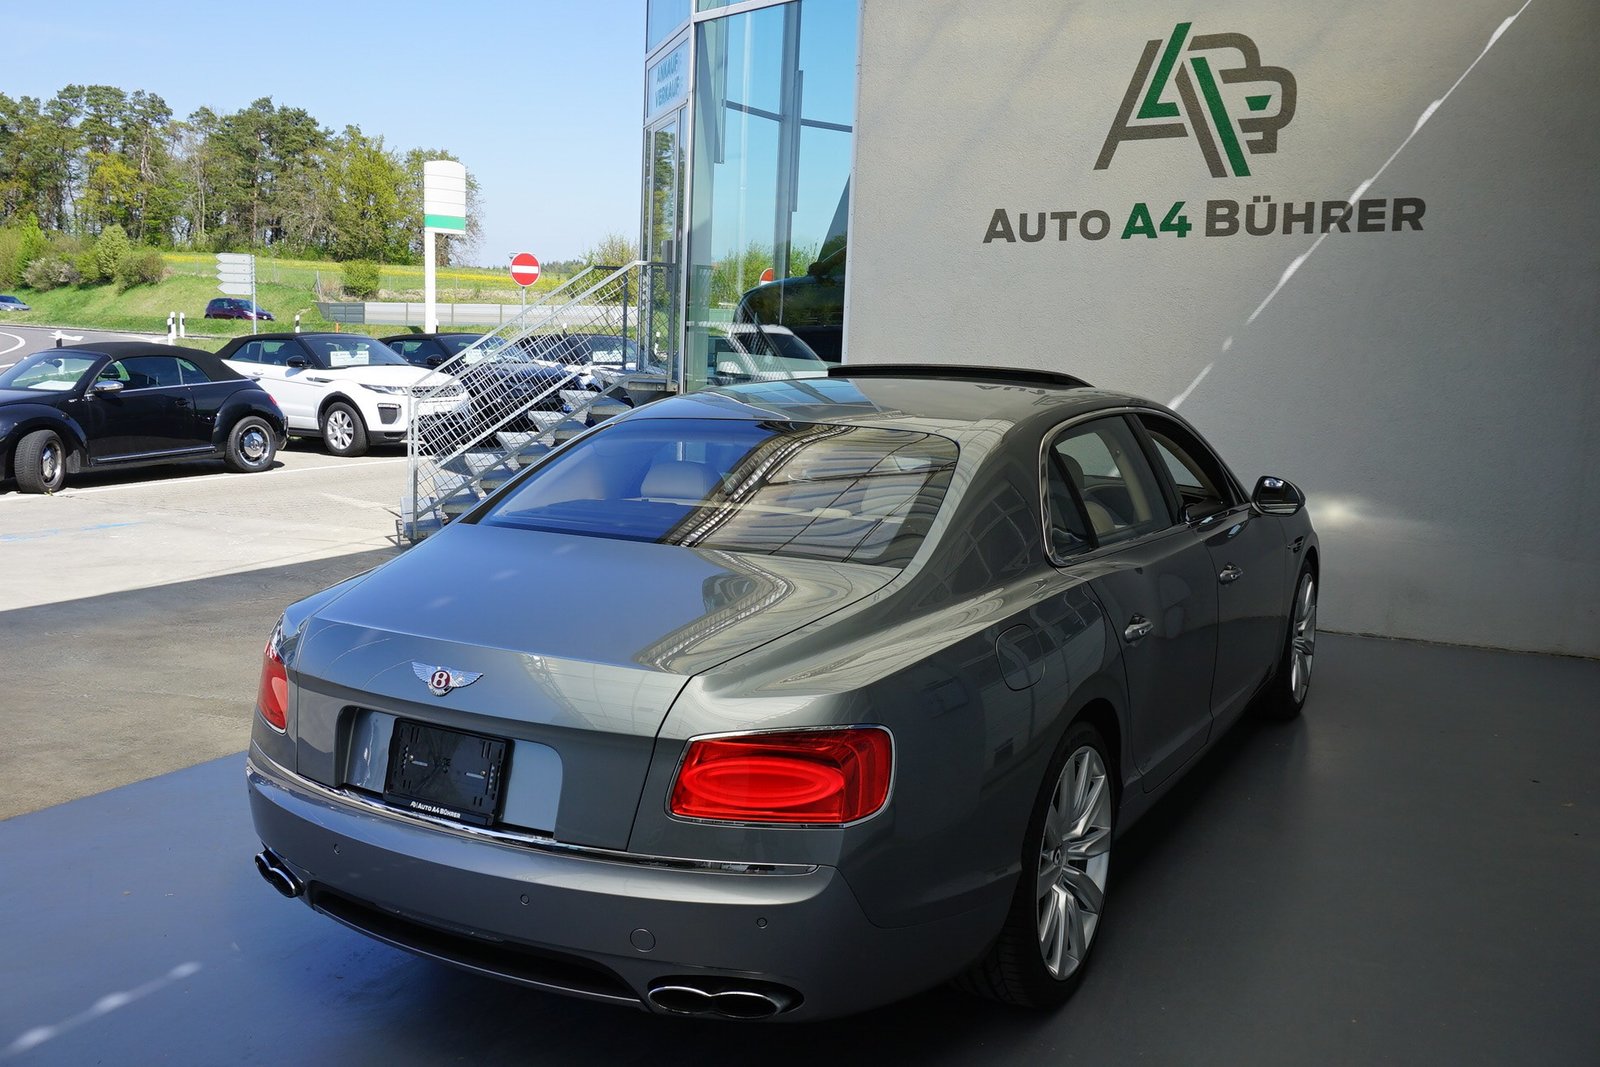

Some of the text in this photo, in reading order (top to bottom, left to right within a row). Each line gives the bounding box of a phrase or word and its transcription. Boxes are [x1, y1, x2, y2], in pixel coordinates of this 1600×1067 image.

[982, 195, 1427, 244] AUTO A4 BÜHRER
[417, 802, 432, 811] AUTO
[431, 806, 440, 814] A4
